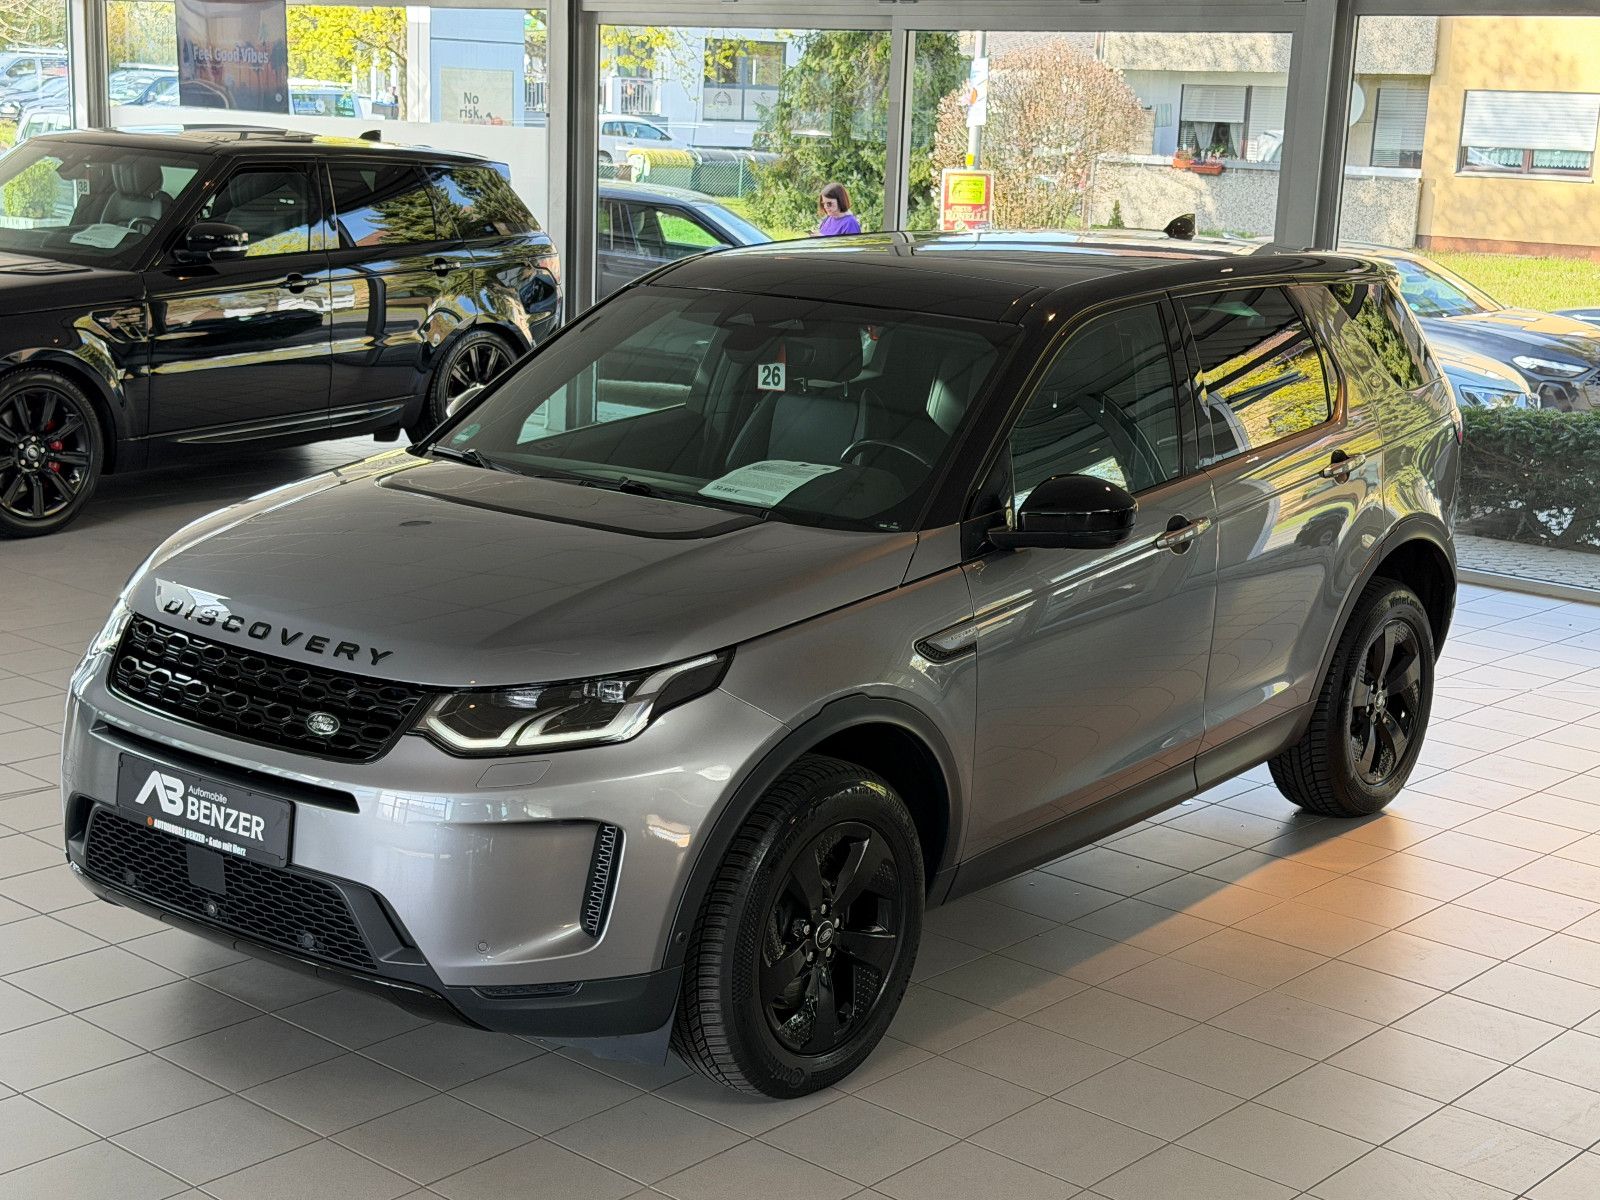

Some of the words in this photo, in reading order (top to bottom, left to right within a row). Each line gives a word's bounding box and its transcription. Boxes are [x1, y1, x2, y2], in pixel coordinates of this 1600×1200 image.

[193, 45, 212, 60] Feel
[215, 46, 240, 62] Good
[241, 46, 269, 63] Vibes
[463, 91, 480, 105] No
[761, 365, 781, 387] 26
[162, 599, 394, 666] DISCOVERY
[135, 770, 185, 817] AB
[187, 784, 228, 804] Automobile
[186, 797, 265, 841] BENZER
[153, 818, 186, 838] AUTOMOBILE
[185, 829, 206, 844] BENZER
[222, 842, 233, 852] mit
[232, 843, 247, 857] Herz
